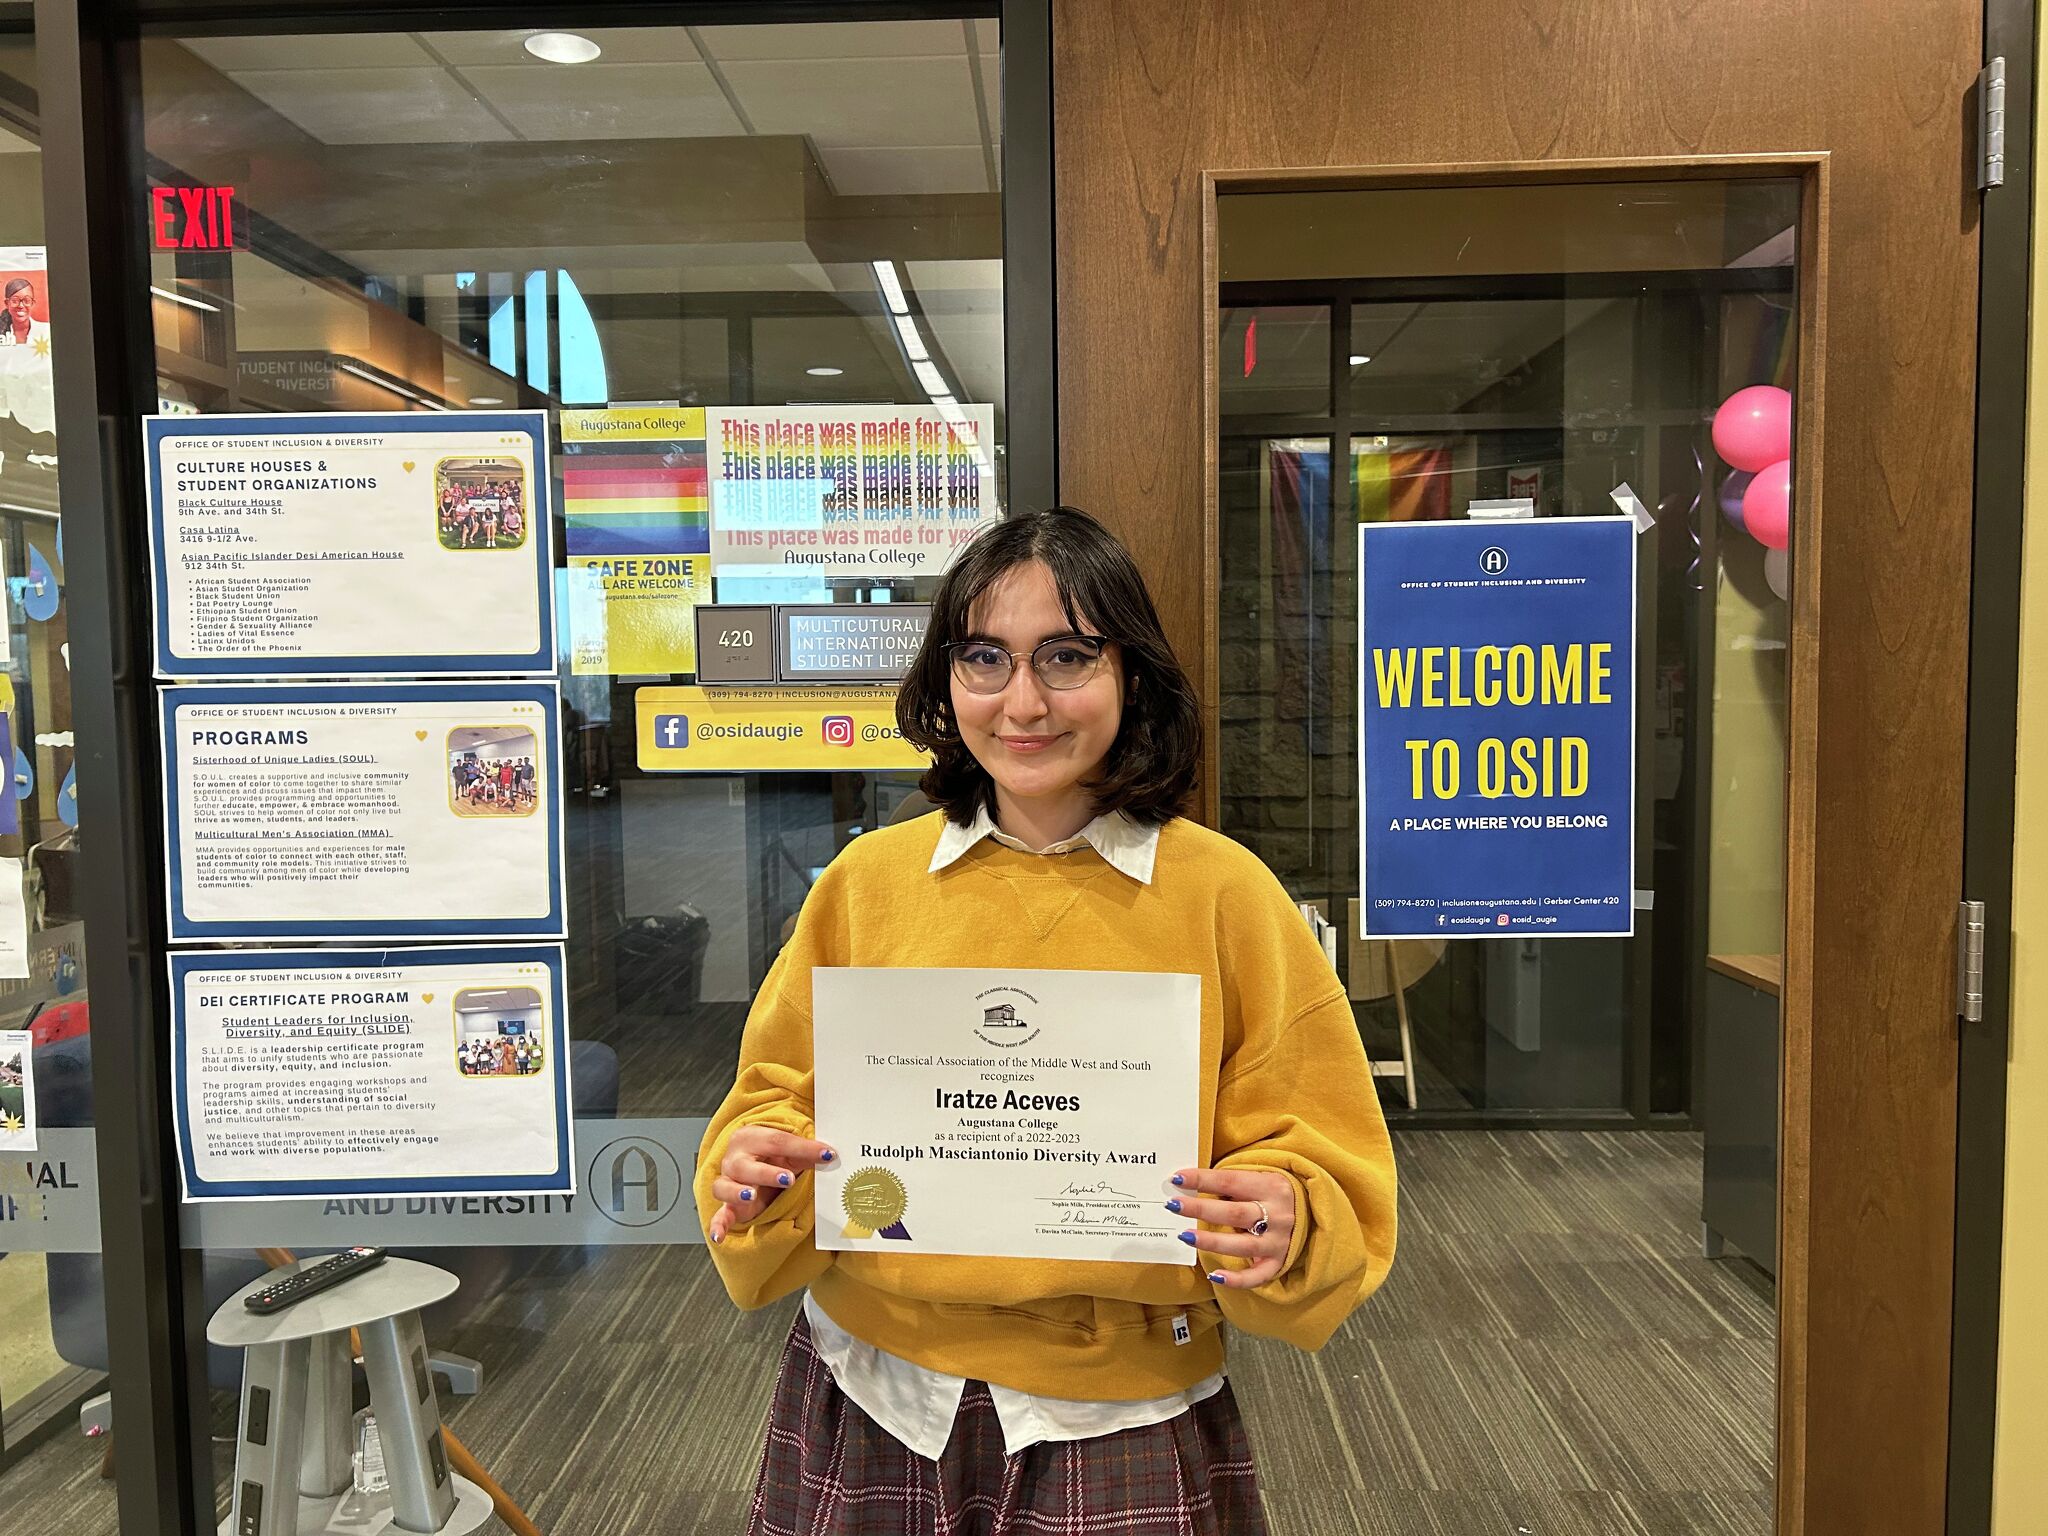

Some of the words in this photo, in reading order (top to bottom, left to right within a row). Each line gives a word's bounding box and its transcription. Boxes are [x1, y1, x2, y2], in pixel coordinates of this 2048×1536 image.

[152, 187, 234, 248] EXIT
[580, 419, 641, 431] Augustana
[643, 418, 686, 431] College
[227, 440, 269, 448] STUDENT
[272, 439, 322, 447] INCLUSION
[325, 439, 331, 447] &
[334, 438, 383, 446] DIVERSITY
[176, 462, 245, 474] CULTURE
[250, 461, 311, 473] HOUSES
[317, 461, 326, 472] &
[177, 479, 246, 491] STUDENT
[252, 478, 376, 490] ORGANIZATIONS
[246, 507, 267, 515] 34th
[271, 507, 284, 515] St.
[179, 526, 205, 534] Casa
[207, 526, 240, 534] Latina
[179, 535, 203, 543] 3416
[213, 553, 248, 561] Pacific
[297, 552, 318, 560] Desi
[372, 551, 404, 559] House
[785, 550, 866, 568] Augustana
[869, 550, 926, 568] College
[587, 561, 638, 577] SAFE
[643, 560, 693, 576] ZONE
[613, 580, 635, 589] ARE
[638, 579, 694, 589] WELCOME
[797, 619, 925, 633] MULTICUTURAL
[719, 630, 753, 647] 420
[582, 656, 602, 664] 2019
[797, 655, 874, 668] STUDENT
[879, 654, 914, 667] LIFE
[1373, 643, 1611, 708] WELCOME
[706, 691, 730, 699] (309)
[192, 730, 308, 746] PROGRAMS
[192, 756, 247, 764] Sisterhood
[264, 756, 299, 765] Unique
[302, 755, 335, 763] Ladies
[338, 755, 376, 764] (SOUL)
[1406, 740, 1460, 799] TO
[1478, 737, 1589, 798] OSID
[1389, 818, 1400, 831] A
[1404, 817, 1451, 831] PLACE
[1454, 817, 1507, 830] WHERE
[1510, 816, 1542, 829] YOU
[1546, 815, 1608, 829] BELONG
[262, 830, 291, 838] Men's
[294, 830, 354, 838] Association
[357, 830, 391, 839] (MMA)
[1374, 899, 1395, 908] (309)
[1397, 899, 1435, 907] 794-8270
[1543, 897, 1572, 906] Gerber
[1573, 897, 1601, 905] Center
[1602, 897, 1619, 905] 420
[198, 975, 231, 983] OFFICE
[249, 974, 290, 982] STUDENT
[293, 973, 342, 981] INCLUSION
[354, 972, 402, 980] DIVERSITY
[200, 996, 223, 1008] DEI
[229, 994, 325, 1008] CERTIFICATE
[331, 992, 408, 1005] PROGRAM
[222, 1017, 269, 1027] Student
[275, 1017, 323, 1026] Leaders
[328, 1015, 345, 1025] for
[351, 1014, 415, 1024] Inclusion,
[226, 1027, 285, 1040] Diversity,
[290, 1026, 311, 1036] and
[317, 1025, 357, 1038] Equity
[362, 1024, 411, 1037] (SLIDE)
[864, 1055, 884, 1065] The
[887, 1056, 932, 1066] Classical
[936, 1057, 995, 1067] Association
[998, 1058, 1008, 1068] of
[1012, 1058, 1027, 1068] the
[1031, 1058, 1067, 1069] Middle
[1071, 1059, 1096, 1070] West
[1099, 1060, 1117, 1070] and
[1121, 1060, 1150, 1071] South
[980, 1072, 1035, 1084] recognizes
[936, 1089, 997, 1110] Iratze
[1003, 1090, 1080, 1111] Aceves
[957, 1118, 1015, 1130] Augustana
[1018, 1119, 1058, 1131] College
[948, 1134, 954, 1142] a
[957, 1132, 1000, 1144] recipient
[1003, 1133, 1013, 1142] of
[1026, 1133, 1080, 1143] 2022-2023
[861, 1145, 923, 1162] Rudolph
[929, 1146, 1028, 1162] Masciantonio
[1034, 1149, 1100, 1166] Diversity
[1105, 1150, 1156, 1165] Award
[324, 1196, 395, 1216] AND
[406, 1193, 576, 1215] DIVERSITY
